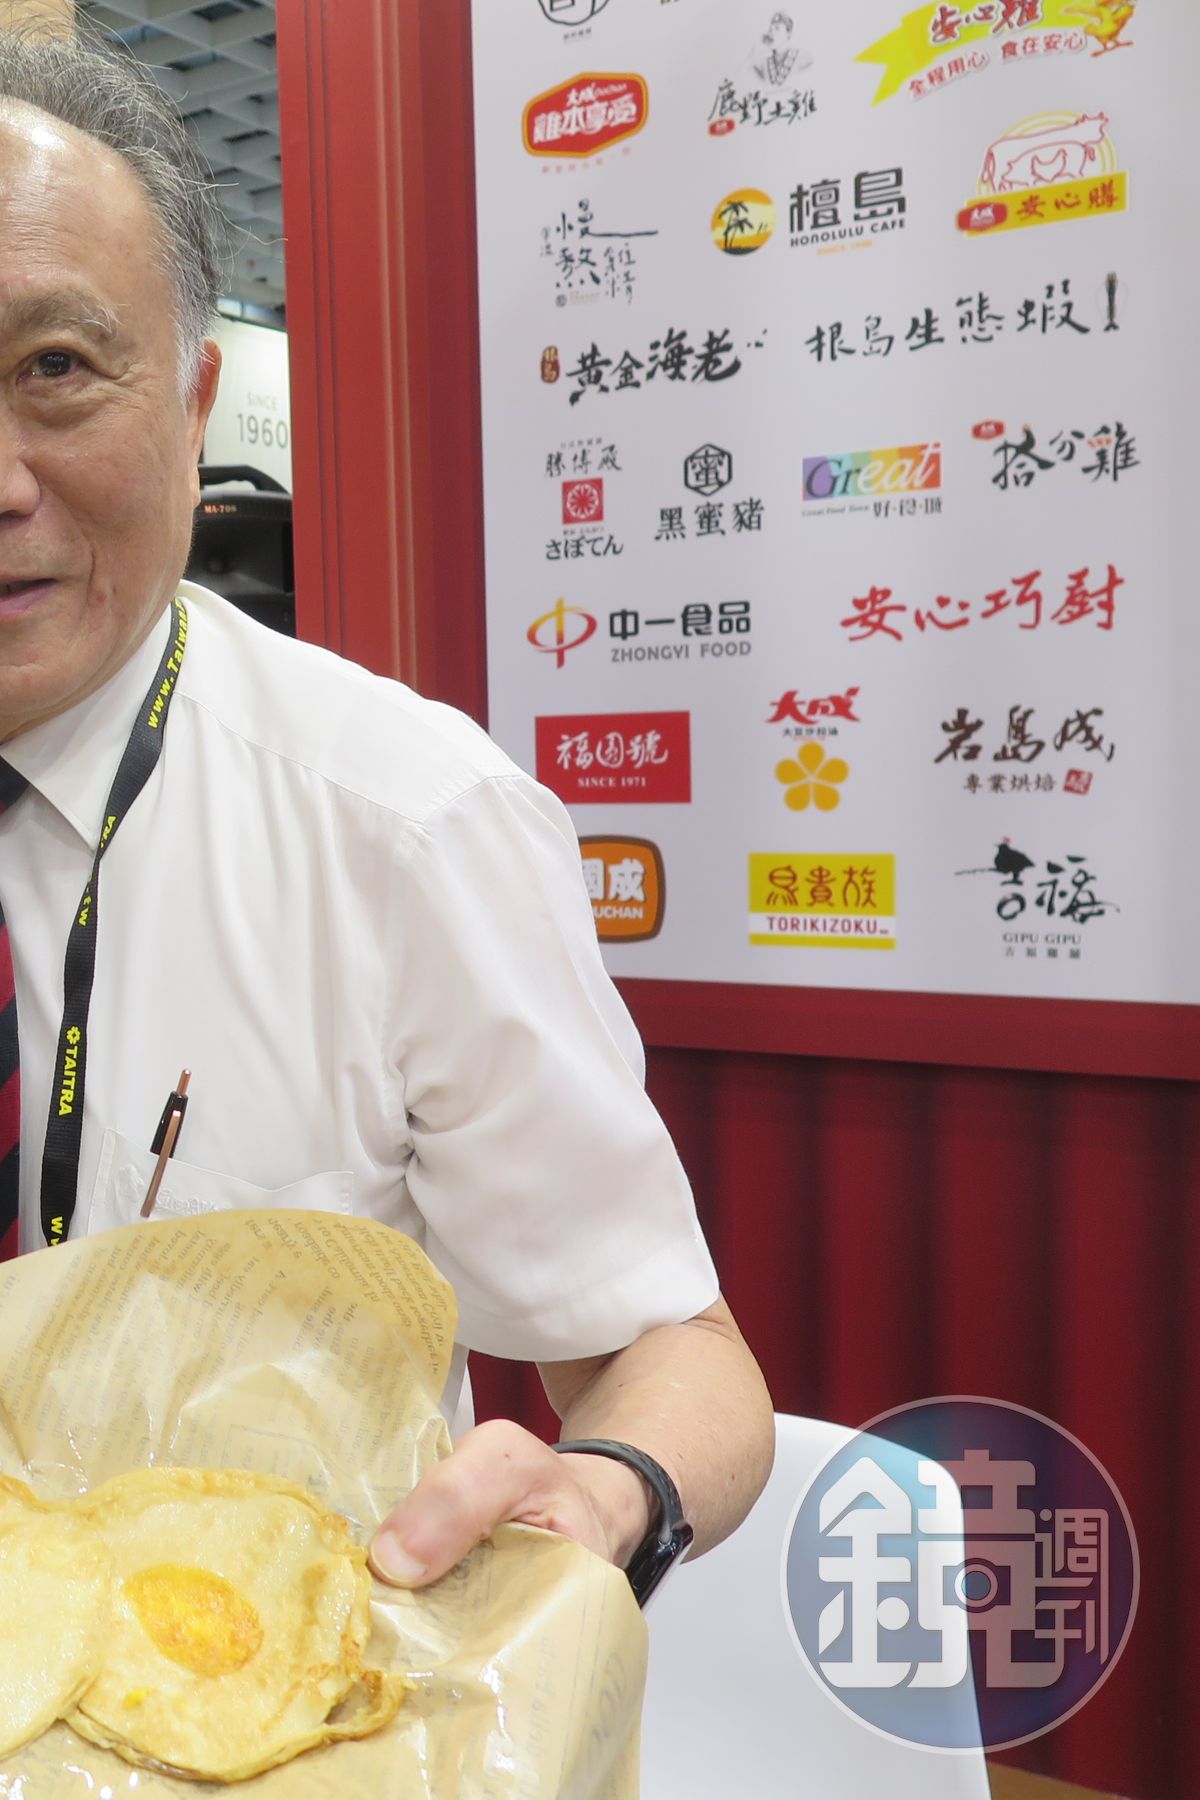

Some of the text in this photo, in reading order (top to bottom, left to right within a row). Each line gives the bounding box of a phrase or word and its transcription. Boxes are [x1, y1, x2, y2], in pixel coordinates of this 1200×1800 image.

[908, 32, 1086, 98] 全程用心 食在安心
[532, 92, 639, 144] 雞本享受
[789, 167, 907, 234] 檀島
[869, 218, 907, 234] CAFE
[246, 391, 278, 411] SINCE
[237, 413, 289, 449] 1960
[690, 448, 725, 490] 蜜
[805, 443, 943, 500] Great
[655, 497, 765, 541] 黑蜜豬
[546, 534, 624, 562] さぼてん
[609, 600, 751, 641] 中一食品
[611, 640, 752, 664] ZHONGYI FOOD
[765, 686, 861, 726] 大成
[578, 775, 647, 788] SINCE 1971
[963, 773, 1057, 796] 專業烘焙
[766, 864, 878, 909] 鳥貴族
[590, 906, 645, 920] UCHAN
[766, 915, 878, 935] TORIKIZOKU
[1003, 932, 1083, 946] GIPU GIPU
[58, 1046, 78, 1117] TAITRA
